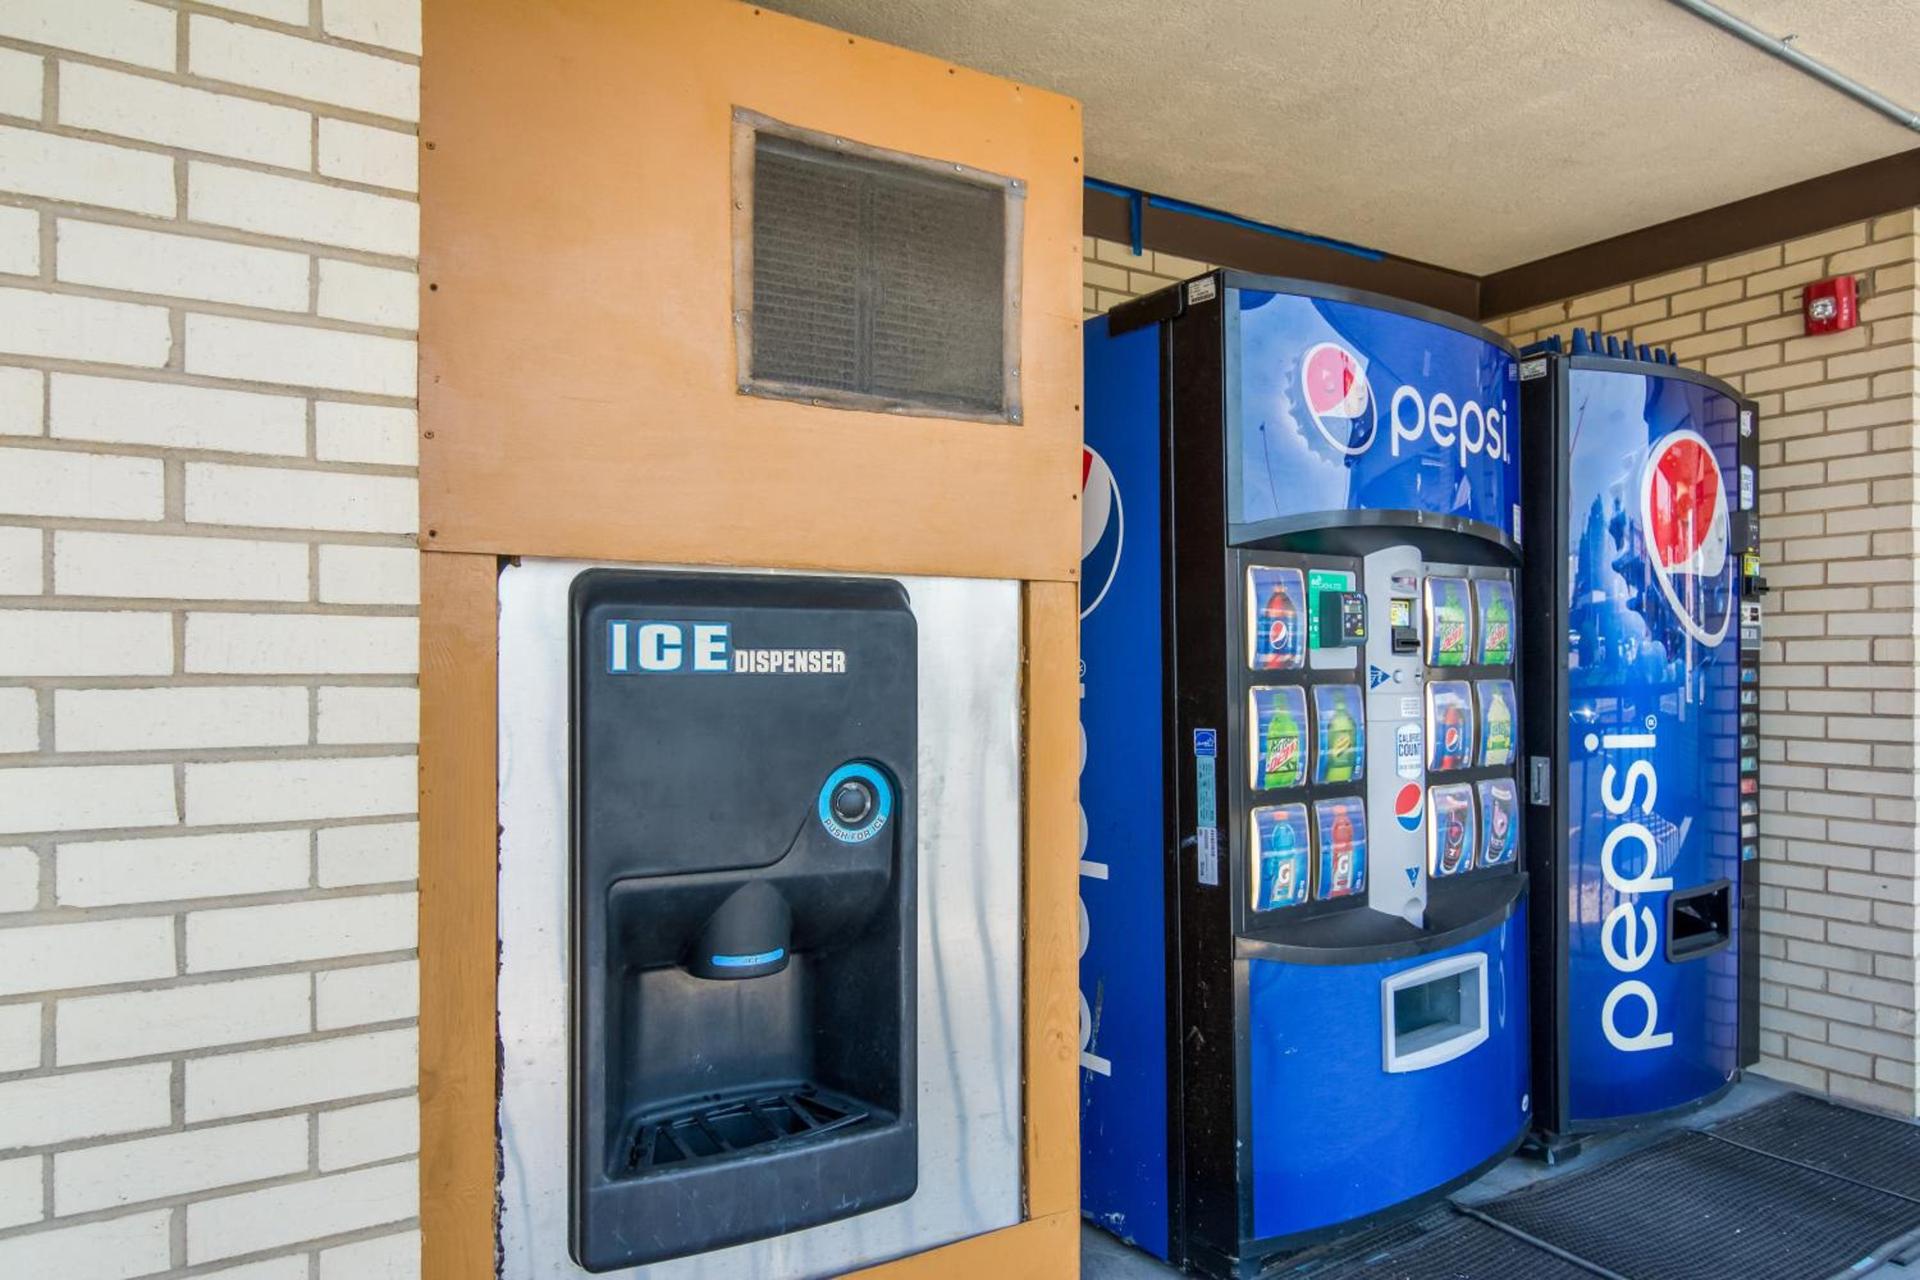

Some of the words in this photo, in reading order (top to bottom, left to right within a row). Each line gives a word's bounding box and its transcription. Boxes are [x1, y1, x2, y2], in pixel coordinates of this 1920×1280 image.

[1391, 385, 1508, 468] pepsi
[611, 623, 728, 672] ICE
[734, 649, 847, 673] DISPENSER
[824, 818, 848, 840] PUSH
[872, 815, 885, 832] ICE
[1584, 733, 1673, 1052] pepsi
